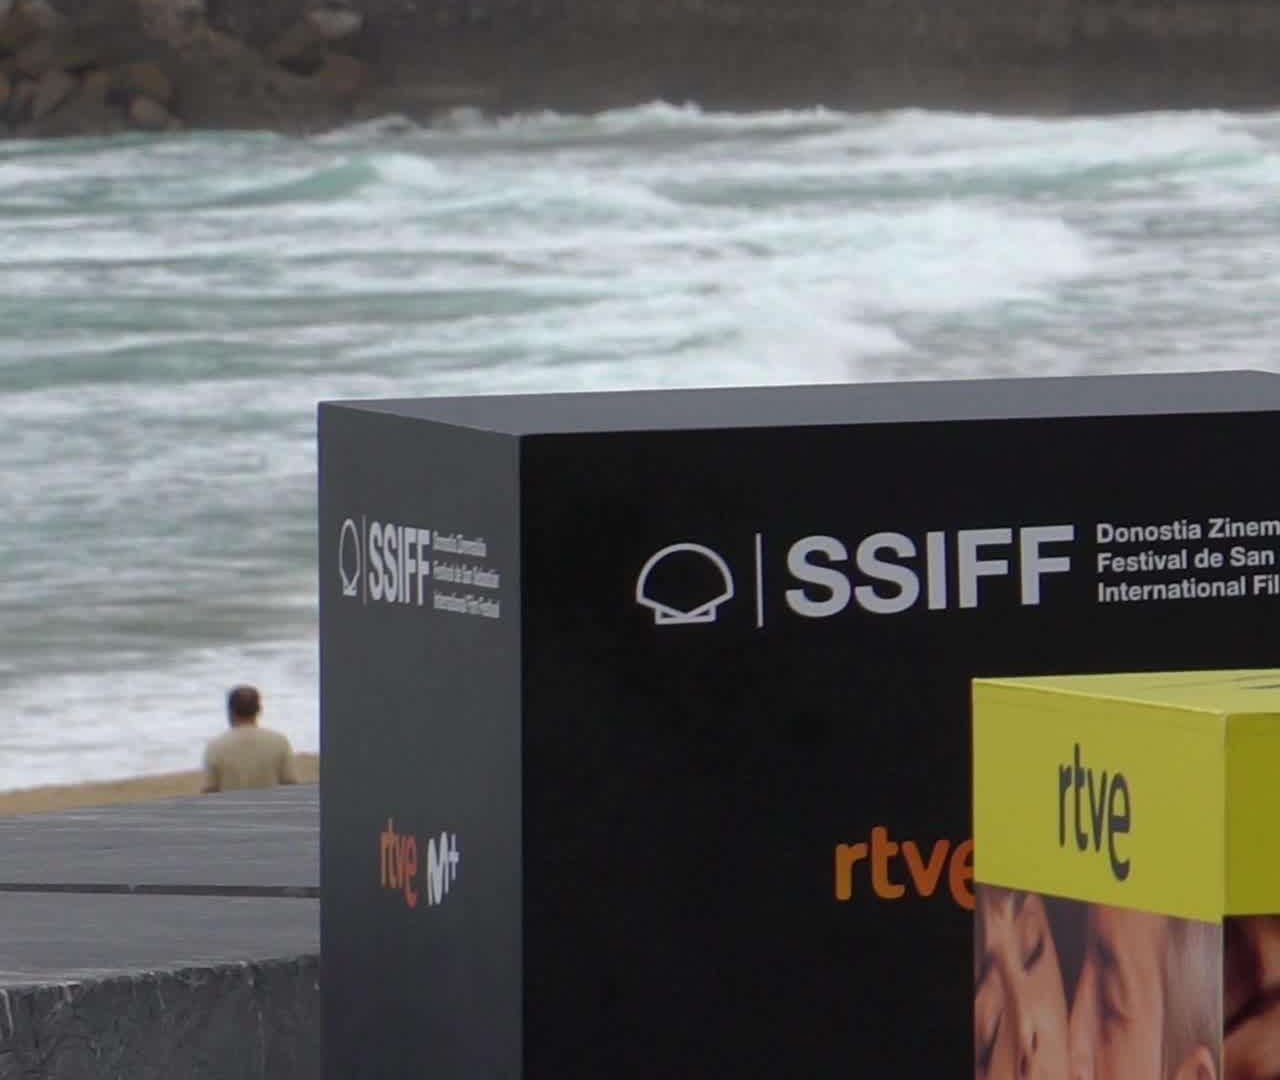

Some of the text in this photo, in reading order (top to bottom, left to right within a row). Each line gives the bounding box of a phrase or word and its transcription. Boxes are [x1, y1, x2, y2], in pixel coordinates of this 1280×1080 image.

[1097, 520, 1201, 543] Donostia
[1097, 547, 1187, 573] Festival
[1194, 547, 1223, 568] de
[1230, 546, 1274, 567] San
[369, 521, 430, 606] SSIFF
[785, 525, 1074, 617] SSIFF
[1098, 575, 1246, 603] International
[1059, 743, 1131, 881] rtve
